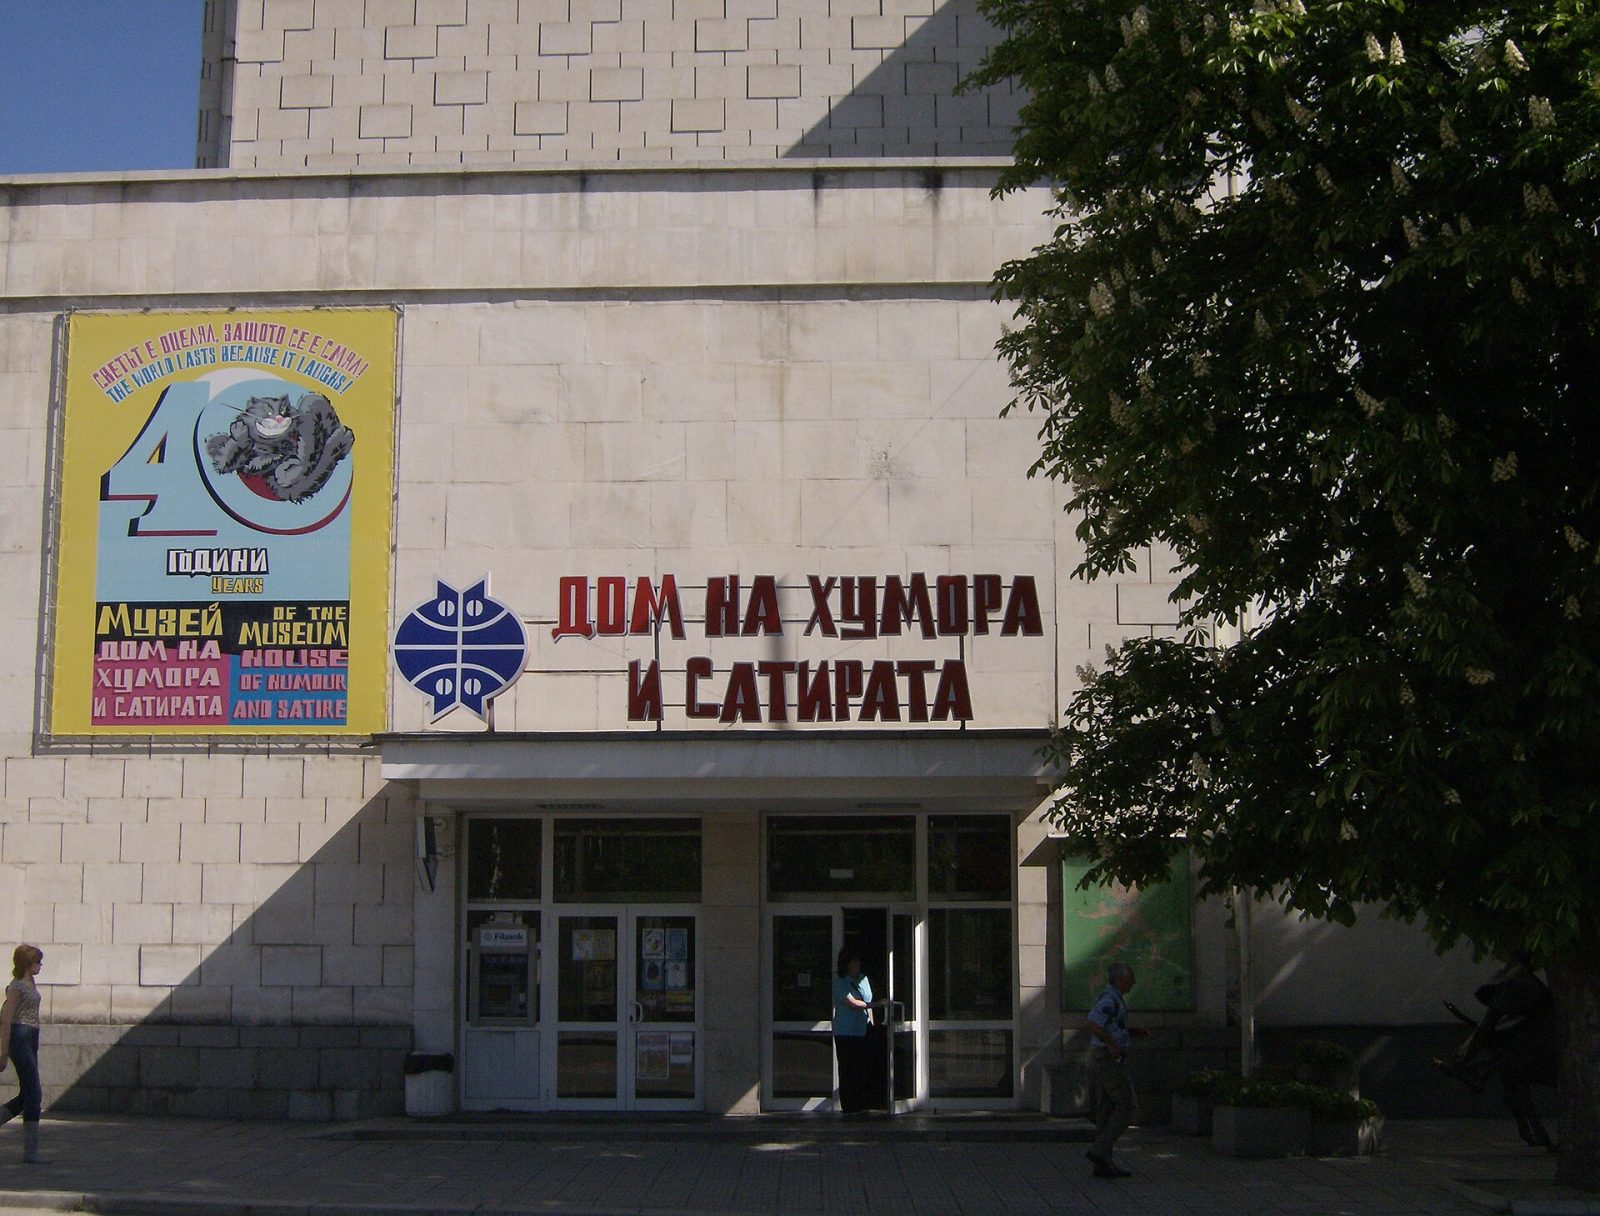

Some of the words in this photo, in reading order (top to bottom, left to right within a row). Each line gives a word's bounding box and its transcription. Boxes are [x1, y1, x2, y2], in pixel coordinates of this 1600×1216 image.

[91, 346, 144, 390] СВЕТЪТ
[144, 340, 158, 360] Е
[224, 321, 287, 345] ЗАЩОТО
[288, 328, 310, 350] СЕ
[308, 335, 322, 354] Е
[105, 379, 133, 404] THE
[131, 356, 174, 388] WORLD
[176, 346, 216, 370] LASTS
[221, 344, 279, 365] BECAUSE
[281, 350, 297, 368] IT
[211, 577, 264, 594] YEARS
[97, 601, 223, 636] МУЗЕЙ
[273, 606, 297, 621] OF
[308, 606, 347, 621] THE
[551, 573, 687, 643] ДОМ
[704, 574, 785, 639] НА
[804, 571, 1044, 641] ХУМОРА
[238, 621, 347, 647] MUSEUM
[97, 640, 168, 662] ДОМ
[178, 639, 222, 661] НА
[240, 649, 348, 668] HOUSE
[96, 667, 221, 693] ХУМОРА
[240, 674, 263, 692] OF
[267, 674, 347, 692] HUMOUR
[627, 658, 664, 722] И
[685, 656, 974, 723] САТИРАТА
[93, 697, 107, 718] И
[114, 695, 223, 718] САТИРАТА
[233, 700, 273, 720] AND
[277, 699, 347, 720] SATIRE
